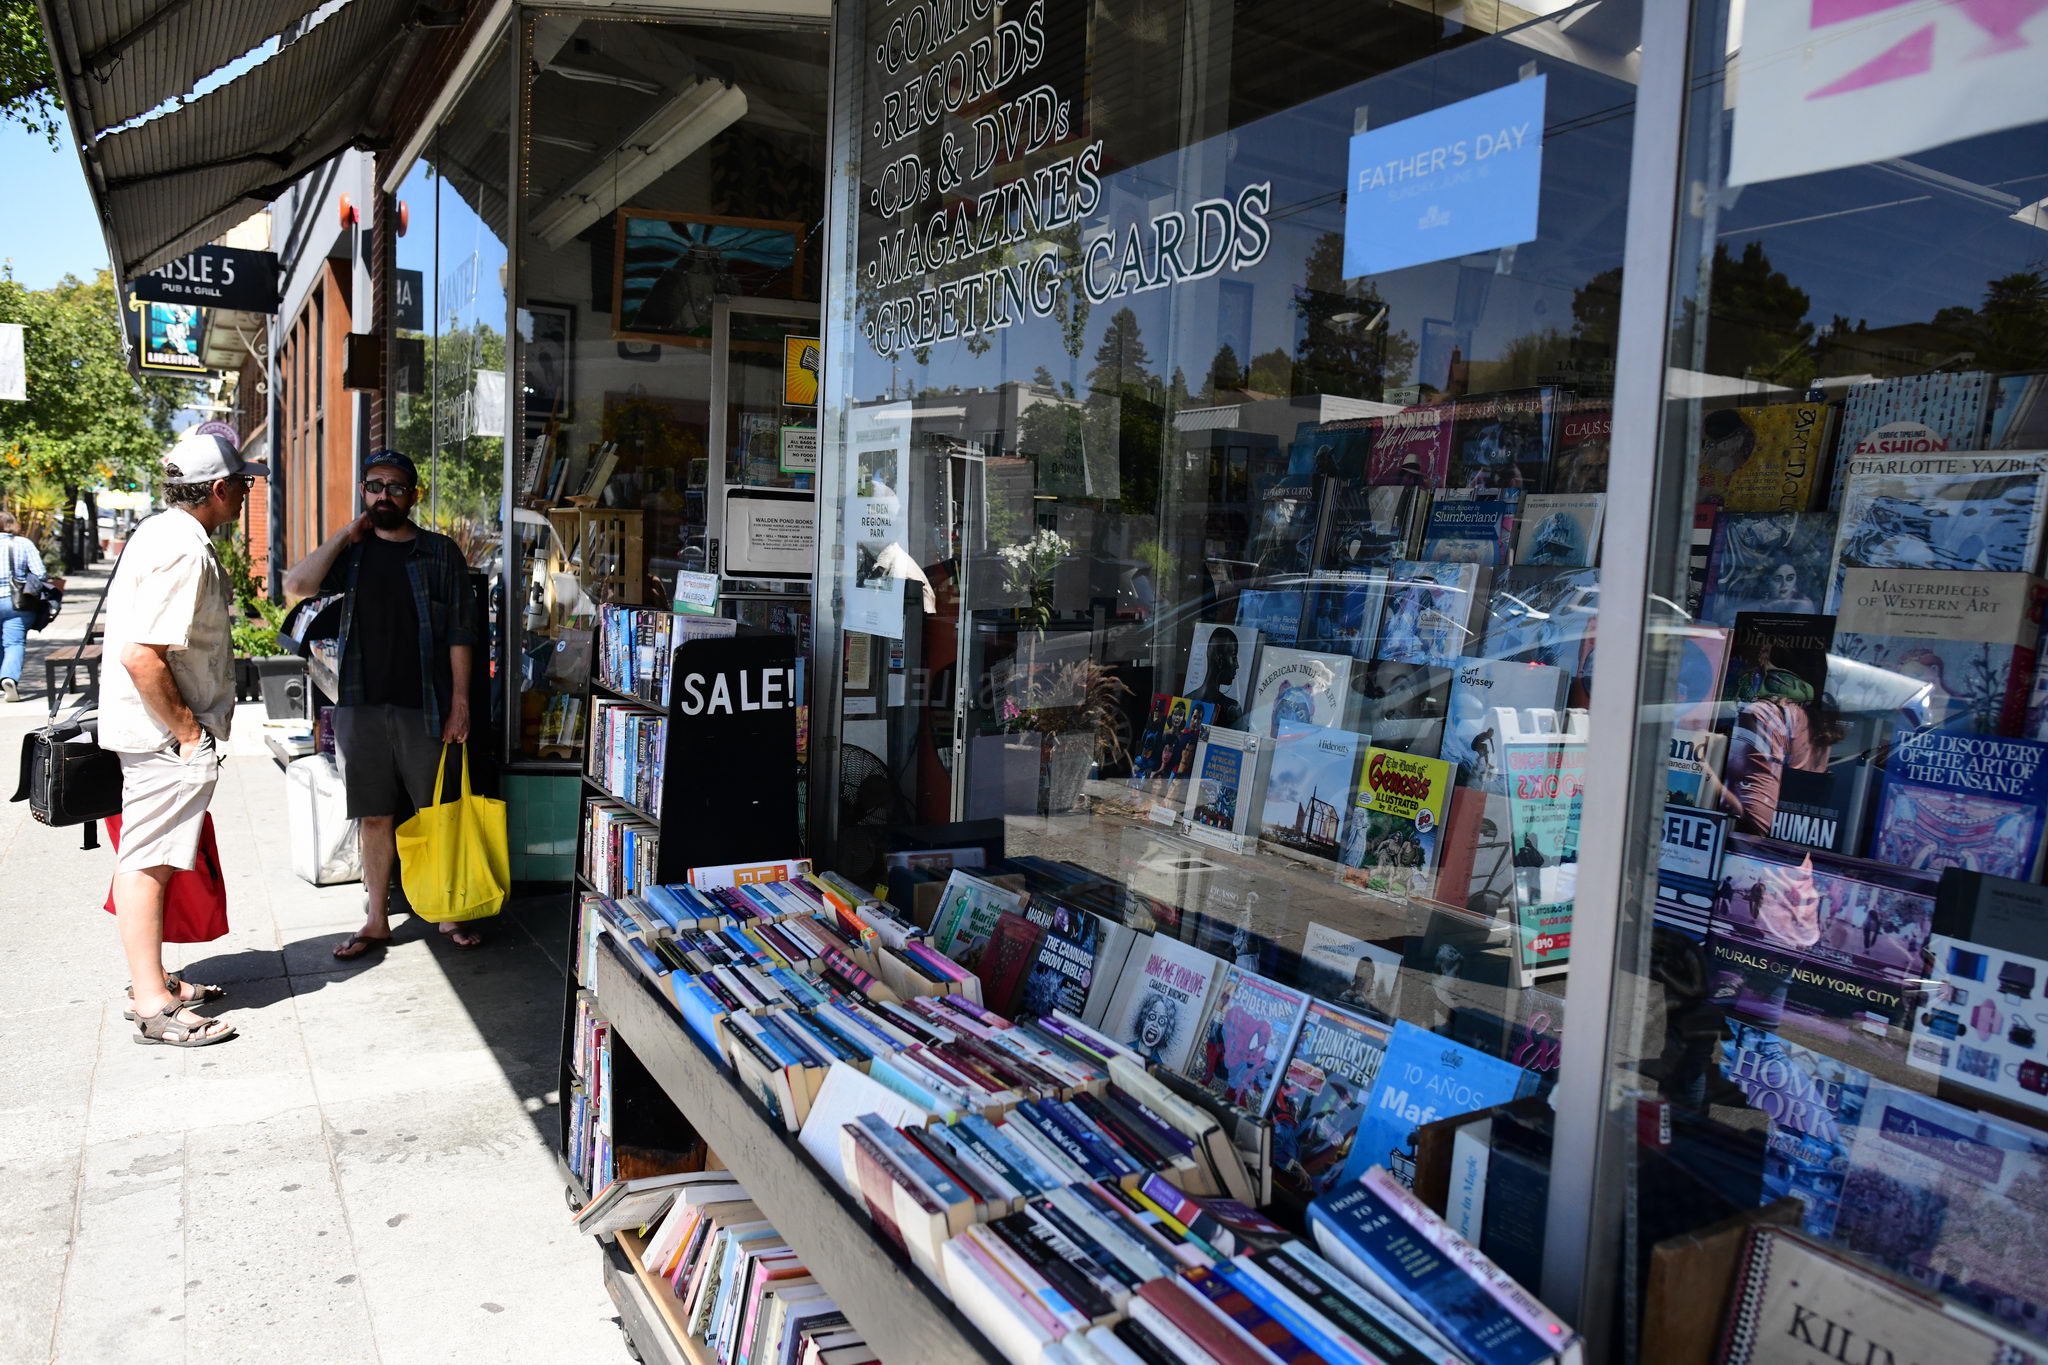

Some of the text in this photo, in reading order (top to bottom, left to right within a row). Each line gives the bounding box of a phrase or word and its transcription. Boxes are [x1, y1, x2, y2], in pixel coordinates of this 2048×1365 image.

[885, 0, 1007, 75] COMI
[882, 0, 1045, 148] RECORDS
[879, 85, 1070, 218] CDs & DVDs
[1358, 122, 1529, 193] FATHER'S DAY
[877, 140, 1103, 289] MAGAZINES
[221, 258, 235, 285] 5
[875, 181, 1271, 357] GREETING CARDS
[162, 283, 222, 297] PUB & GRILL
[1856, 439, 1949, 454] FASHION
[1850, 460, 1957, 474] CHARLOTTE
[861, 517, 892, 527] REGIONAL
[1434, 511, 1498, 523] Slumberland
[869, 528, 885, 538] PARK
[1872, 580, 1991, 597] MASTERPIECES
[1857, 594, 2001, 613] OF WESTERN ART
[1736, 627, 1826, 650] Dinosaurs
[1460, 673, 1494, 689] Odyssey
[1461, 665, 1479, 676] Surf
[681, 668, 795, 716] SALE!
[1258, 663, 1298, 696] AMERICAN
[1324, 687, 1337, 709] ART
[1319, 740, 1350, 753] Hideouts
[1898, 731, 2045, 764] THE DISCOVERY
[1369, 753, 1431, 801] Genesis
[1386, 756, 1398, 769] The
[1400, 759, 1417, 774] Book
[1899, 748, 2037, 780] OF THE ART OF
[1907, 764, 2024, 796] THE INSANE
[1375, 792, 1419, 811] ILLUSTRATED
[1378, 803, 1385, 811] by
[1393, 806, 1411, 816] Crumb
[1770, 810, 1838, 850] HUMAN
[970, 907, 998, 927] Mariju
[986, 901, 1001, 915] Indo
[1044, 934, 1093, 969] THE CANNABIS
[1038, 949, 1083, 981] GROW BIBLE
[1714, 945, 1900, 1008] MURALS OF NEW YORK CITY
[1149, 979, 1168, 994] CHARLES
[1346, 1028, 1362, 1039] THE
[1315, 1054, 1370, 1087] MONSTER
[1732, 1047, 1841, 1112] HOME
[1403, 1062, 1485, 1111] 10 AÑOS
[1379, 1085, 1443, 1125] Maf
[1328, 1188, 1369, 1214] HOME
[1353, 1204, 1372, 1221] TO
[1359, 1215, 1391, 1235] WAR
